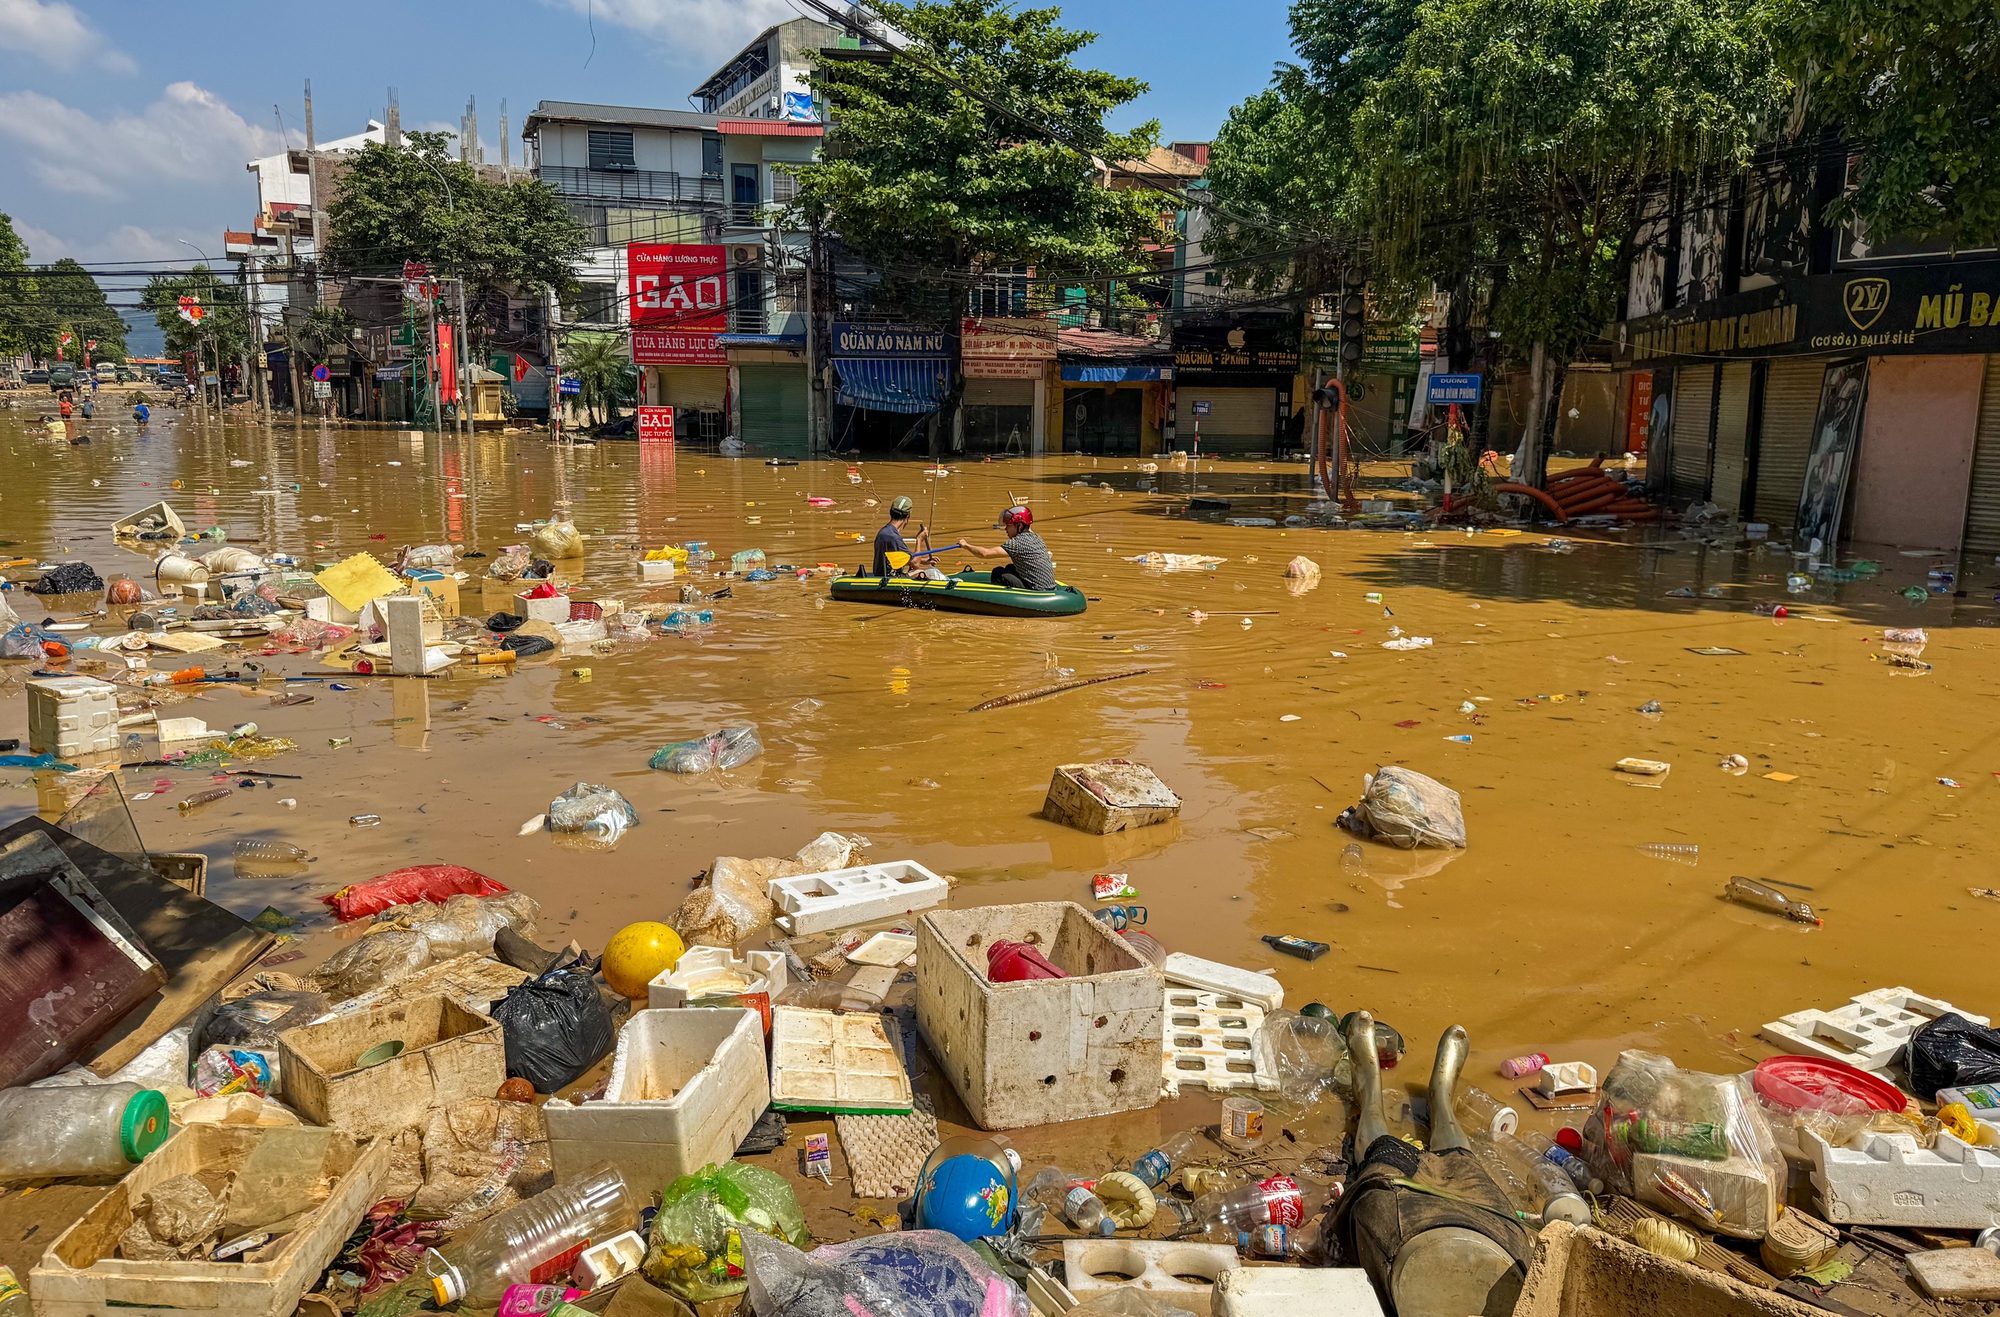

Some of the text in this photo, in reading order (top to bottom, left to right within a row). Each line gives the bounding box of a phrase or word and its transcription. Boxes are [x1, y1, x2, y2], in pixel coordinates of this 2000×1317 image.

[636, 252, 718, 265] CỬA HÀNG LƯƠNG THỰC
[1915, 283, 1964, 328] MŨ
[636, 335, 656, 349] CỬA
[658, 335, 685, 349] HÀNG
[689, 338, 706, 352] LỤC
[876, 332, 893, 350] ÁO
[896, 335, 923, 350] NAM
[1431, 385, 1476, 399] PHAN ĐÌNH PHÙNG
[640, 414, 672, 430] GẠO
[654, 429, 672, 437] TUYẾT
